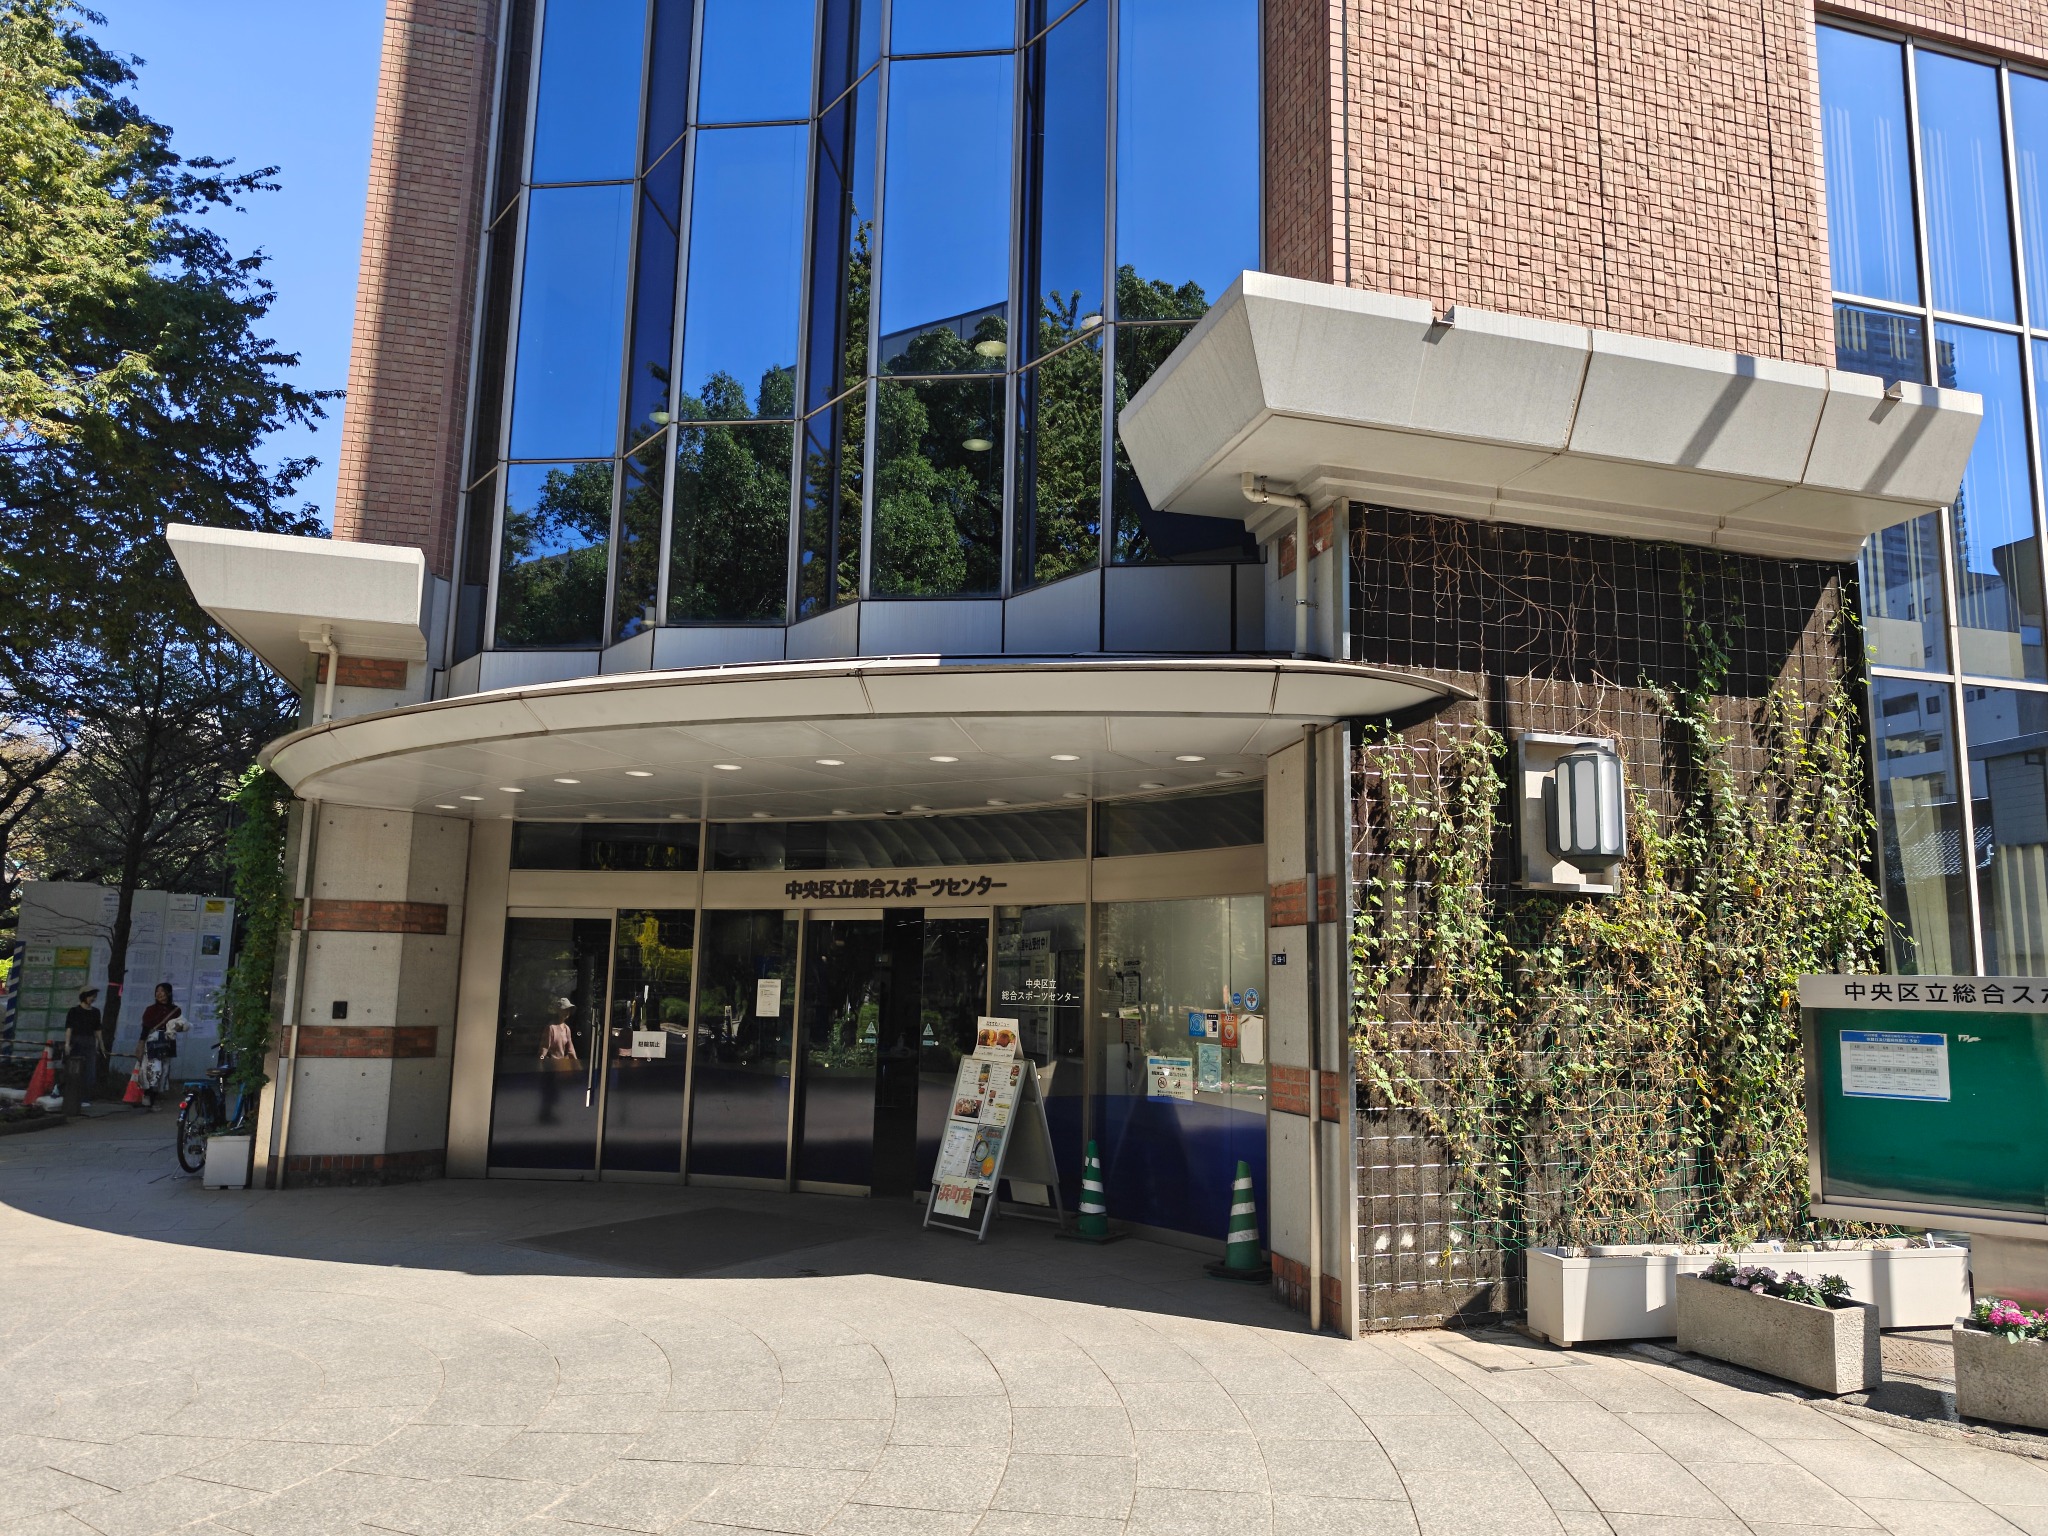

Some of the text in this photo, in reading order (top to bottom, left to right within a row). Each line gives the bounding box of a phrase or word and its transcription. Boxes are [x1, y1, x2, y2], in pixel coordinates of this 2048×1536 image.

[785, 876, 1007, 900] 中央区立総合スポーツセンター
[1025, 978, 1057, 989] 中央区立
[1001, 990, 1080, 1002] 総合スポーツセンター
